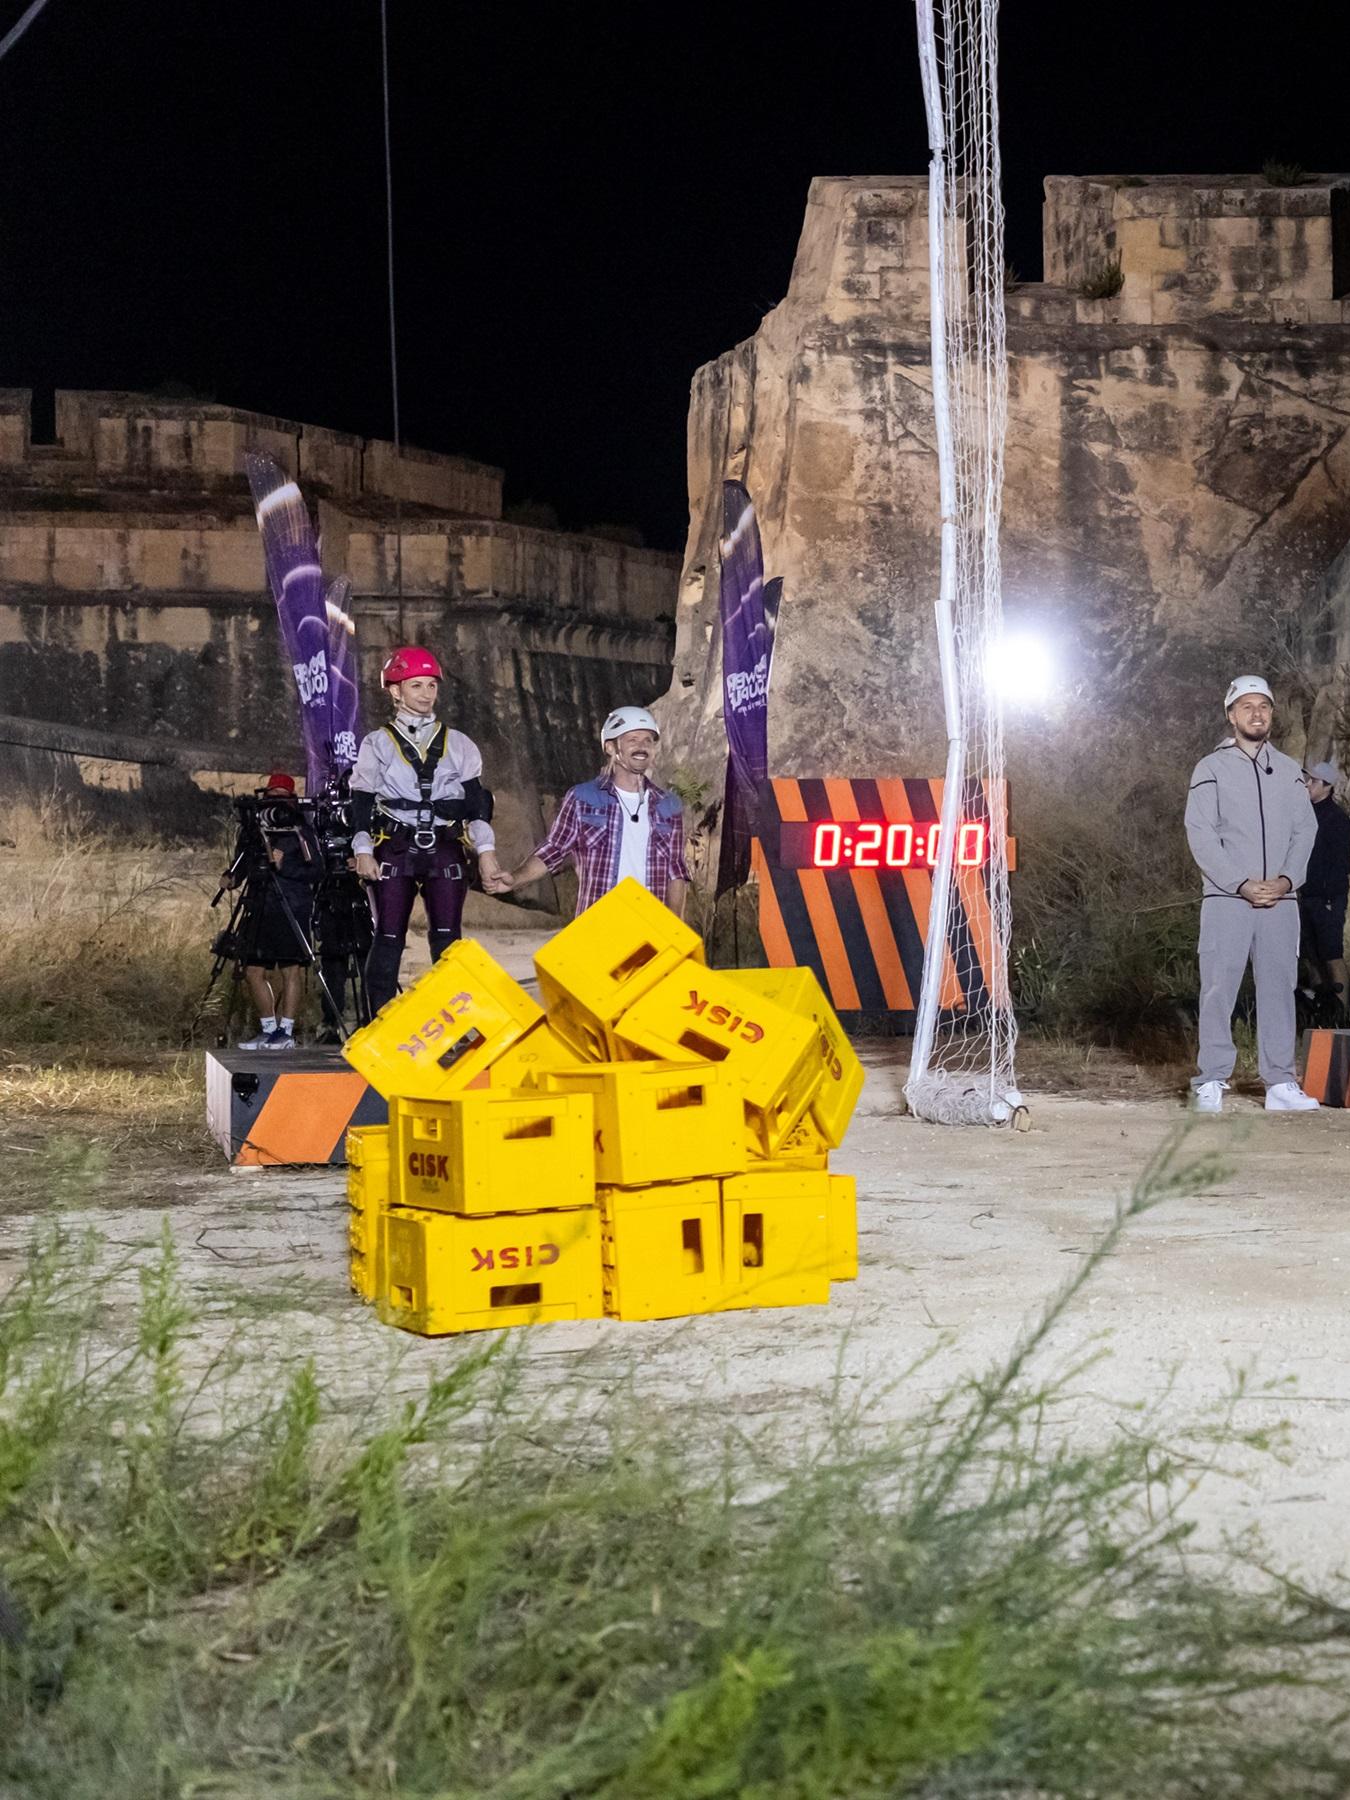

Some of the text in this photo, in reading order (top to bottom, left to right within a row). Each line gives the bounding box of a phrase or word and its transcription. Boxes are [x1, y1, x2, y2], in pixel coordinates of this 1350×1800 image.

[397, 991, 473, 1061] CISK
[680, 990, 765, 1044] CISK
[813, 1012, 842, 1081] CIS
[408, 1152, 449, 1183] CISK
[471, 1243, 561, 1272] CISK
